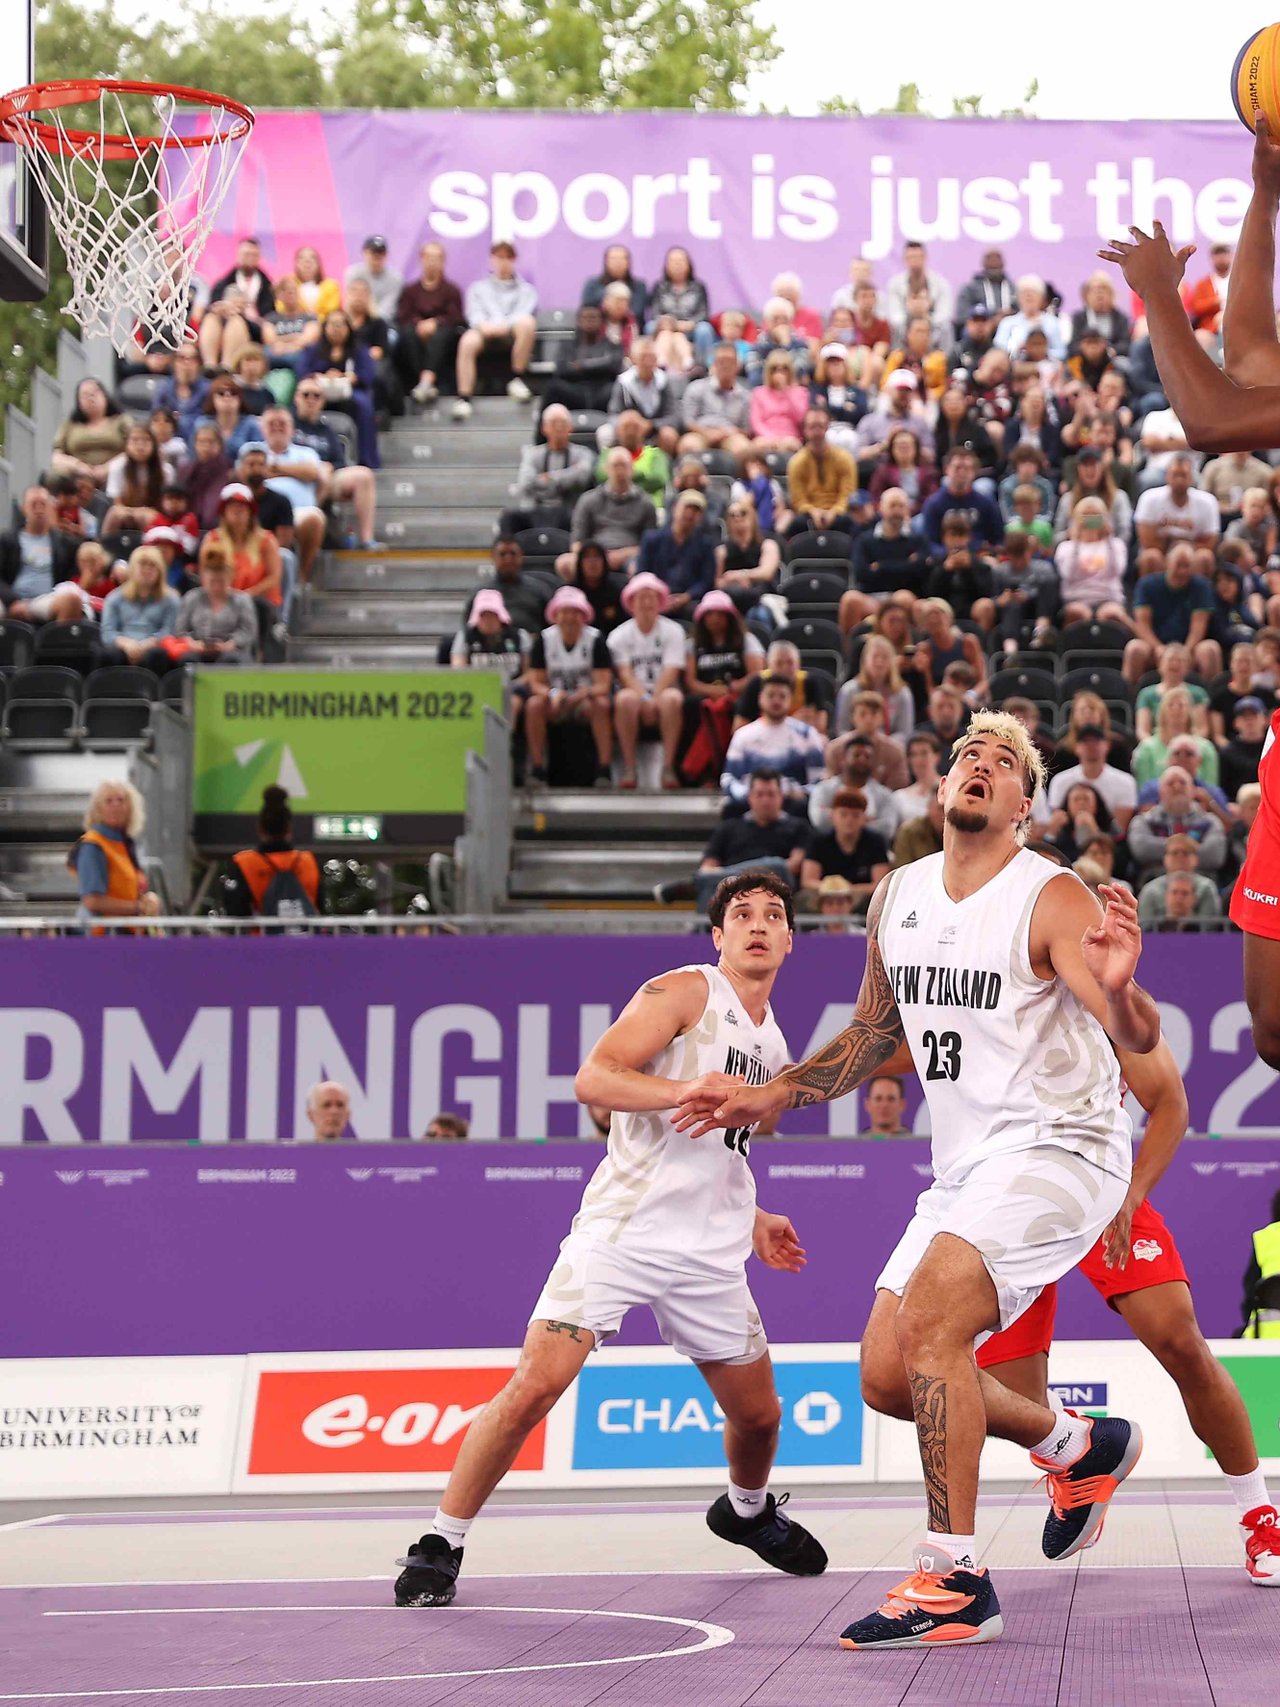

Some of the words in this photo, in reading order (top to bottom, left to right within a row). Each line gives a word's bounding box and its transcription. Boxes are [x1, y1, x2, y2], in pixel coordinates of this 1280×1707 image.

[1249, 56, 1261, 81] 2022
[428, 157, 722, 242] sport
[752, 154, 839, 241] is
[861, 155, 1064, 259] just
[1088, 157, 1250, 242] the
[224, 692, 398, 719] BIRMINGHAM
[407, 691, 475, 718] 2022
[1243, 888, 1279, 906] KUKRI
[925, 966, 1002, 1010] ZEALAND
[922, 1029, 962, 1082] 23
[3, 1405, 173, 1425] UNIVERSITY
[0, 1427, 200, 1448] BIRMINGHAM
